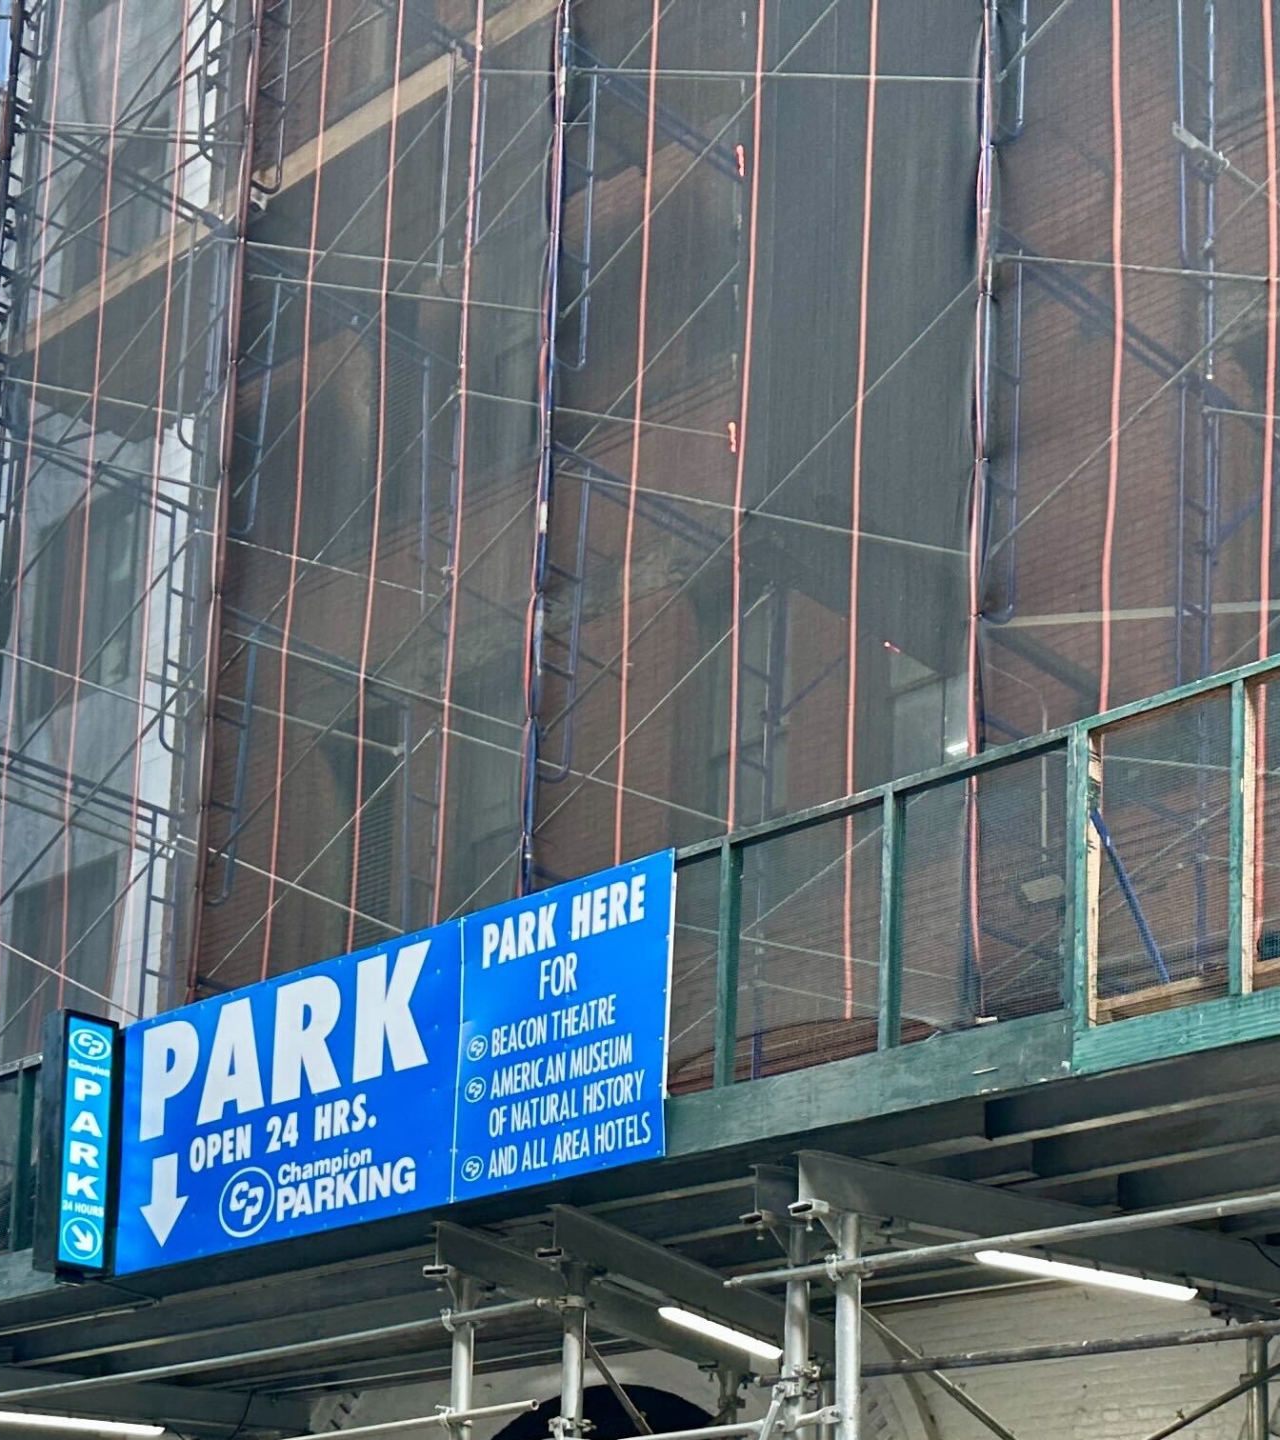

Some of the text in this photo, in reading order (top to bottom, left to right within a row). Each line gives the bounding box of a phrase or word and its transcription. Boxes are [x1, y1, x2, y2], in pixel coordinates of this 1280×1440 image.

[482, 874, 646, 969] PARK HERE
[539, 952, 578, 1000] FOR
[139, 939, 432, 1142] PARK
[491, 1014, 548, 1058] BEACON
[551, 994, 617, 1041] THEATRE
[490, 1052, 566, 1100] AMERICAN
[569, 1032, 633, 1079] MUSEUM
[189, 1093, 377, 1173] OPEN 24 HRS.
[489, 1069, 646, 1138] OF NATURAL HISTORY
[66, 1077, 103, 1200] PARK
[277, 1148, 372, 1186] Champion
[487, 1144, 518, 1180] AND
[521, 1137, 549, 1172] ALL
[552, 1127, 590, 1166] AREA
[594, 1111, 652, 1155] HOTELS
[62, 1200, 105, 1218] 24 HOURS
[276, 1156, 417, 1222] PARKING
